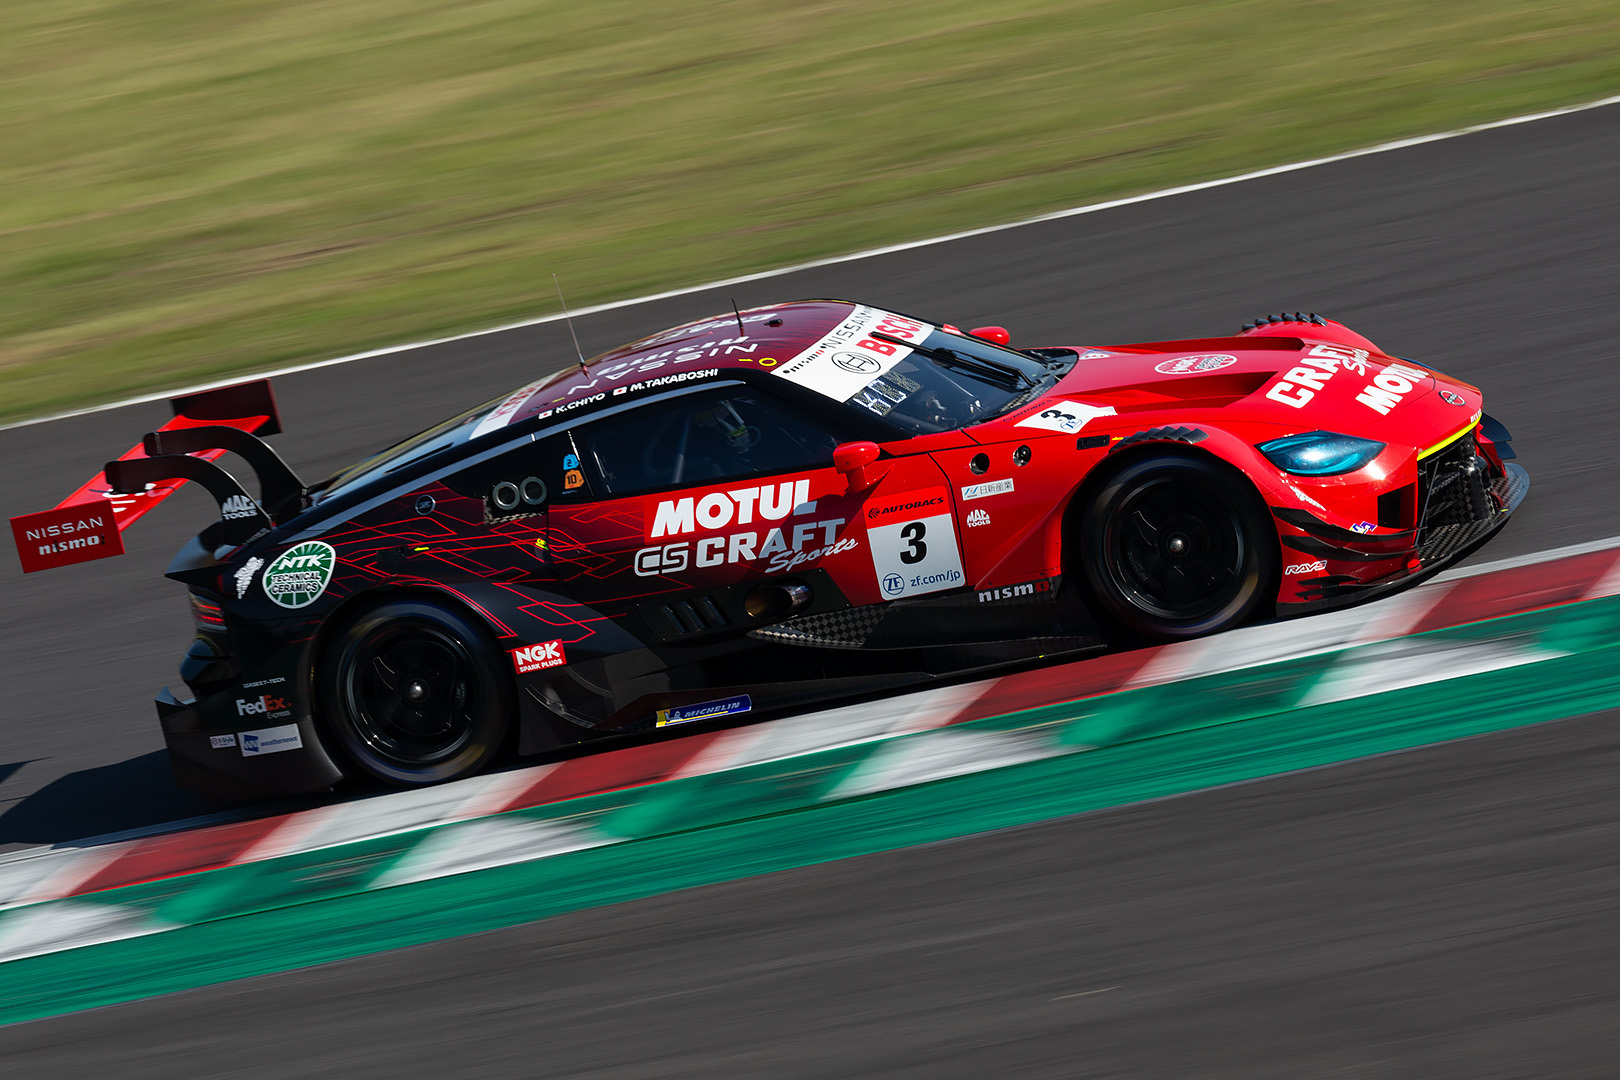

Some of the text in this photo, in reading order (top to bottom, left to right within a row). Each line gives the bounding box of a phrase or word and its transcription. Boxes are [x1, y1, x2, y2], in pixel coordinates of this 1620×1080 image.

[567, 343, 758, 395] NISSAN
[630, 368, 719, 391] M.TAKABOSHI
[1265, 344, 1354, 409] CRAFT
[1355, 362, 1429, 416] MOTUL
[567, 474, 577, 485] 10
[222, 509, 258, 520] TOOLS
[650, 479, 817, 538] MOTUL
[881, 496, 944, 515] AUTOBACS
[966, 509, 990, 523] MAC
[26, 516, 104, 541] NISSAN
[39, 535, 100, 556] nismo
[695, 518, 845, 568] CRAFT
[900, 521, 928, 565] 3
[278, 553, 326, 570] NTK
[765, 537, 859, 573] Sports
[270, 570, 322, 583] TECHNICAL
[1285, 560, 1328, 575] RAYS
[270, 581, 319, 594] CERAMICS
[884, 569, 961, 592] ZF zf.com/jp
[978, 580, 1050, 603] nismo
[515, 641, 560, 666] NGK
[519, 658, 563, 673] SPARK PLUGS
[236, 695, 287, 716] FedEx
[684, 702, 740, 718] MICHELIN
